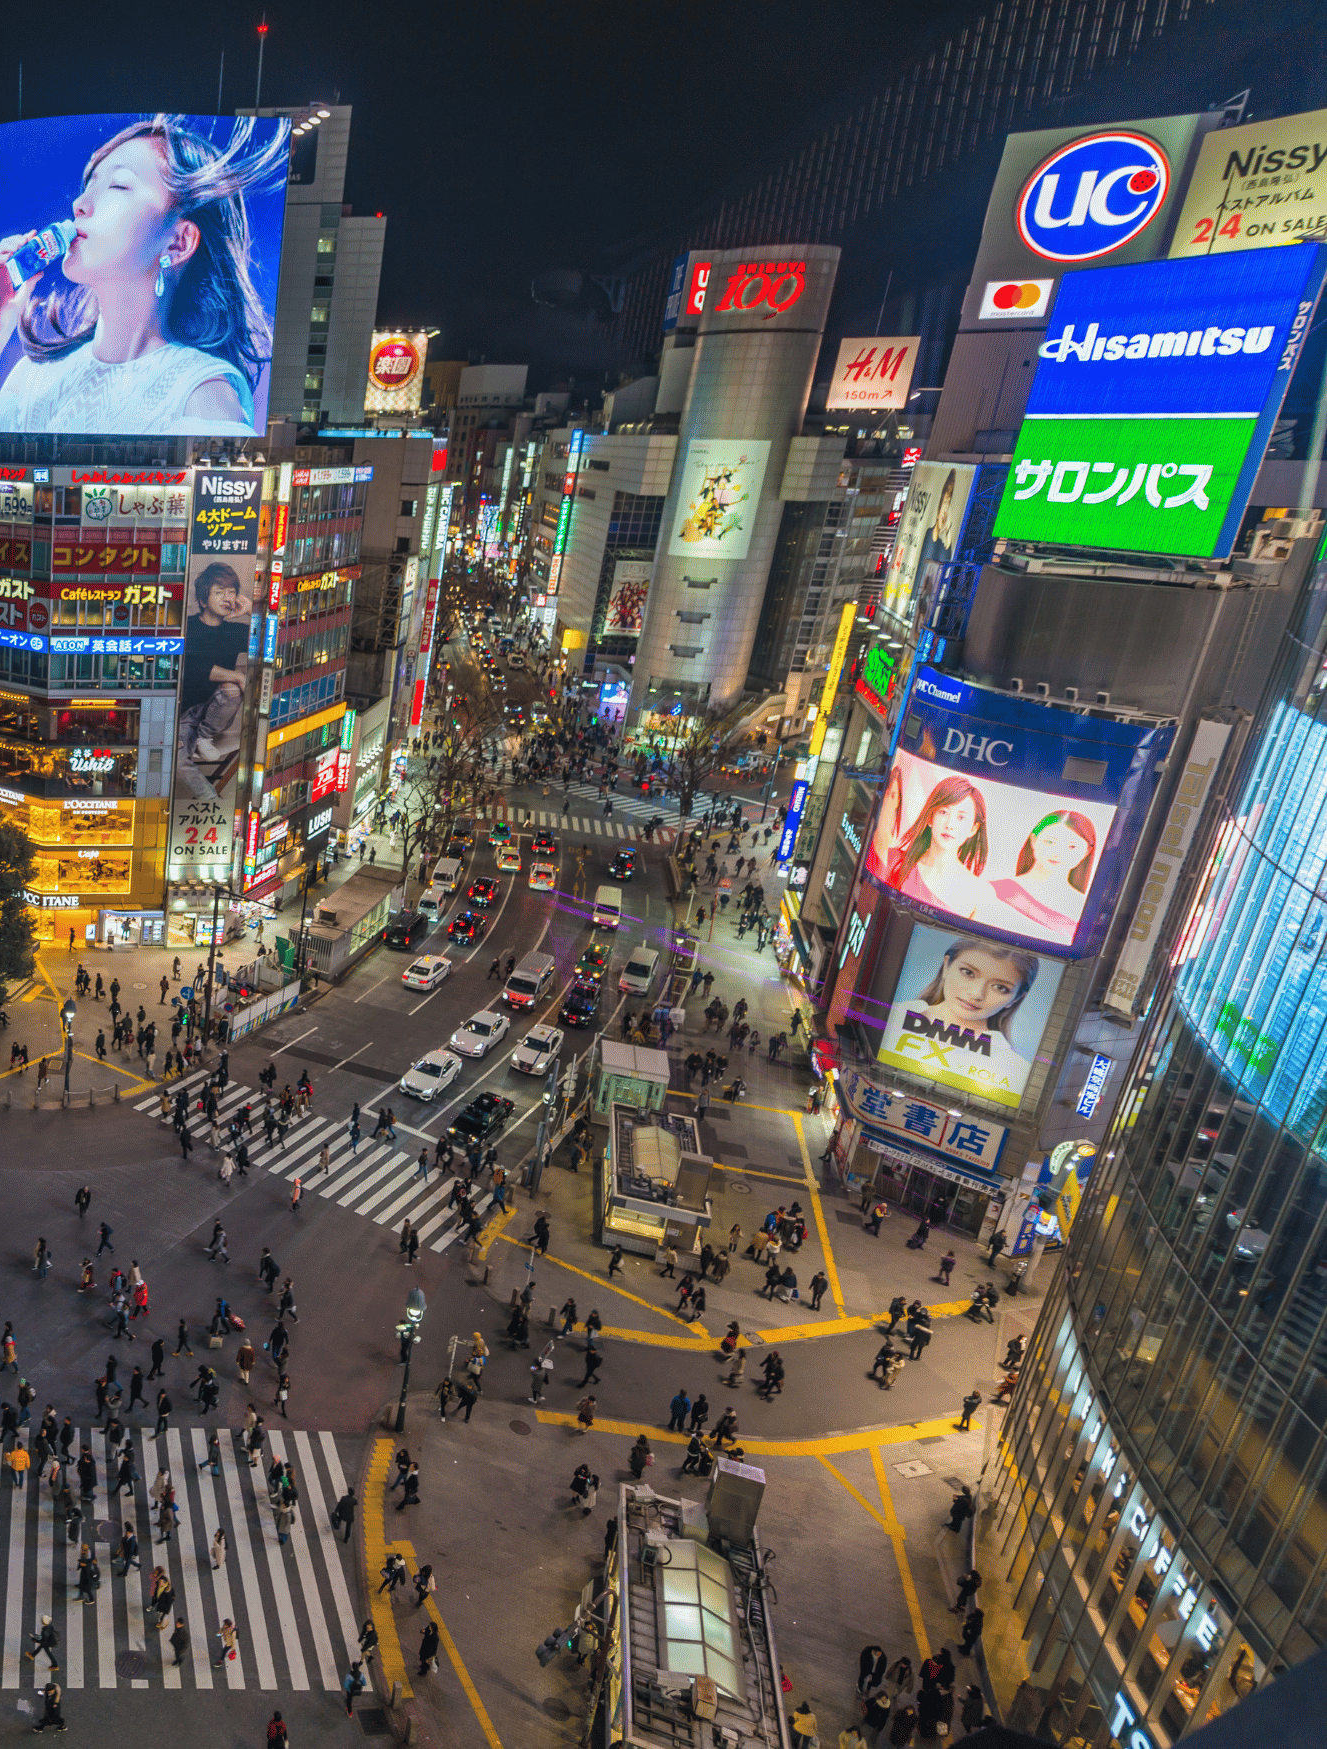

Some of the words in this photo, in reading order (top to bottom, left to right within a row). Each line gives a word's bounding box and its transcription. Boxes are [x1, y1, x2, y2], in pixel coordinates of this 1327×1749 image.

[1222, 142, 1327, 181] Nissy
[1217, 187, 1315, 212] ベストアルバム
[1245, 224, 1275, 238] ON
[1283, 215, 1327, 234] SALE
[737, 262, 806, 274] SHIBUYA
[715, 272, 805, 320] 109
[1038, 323, 1275, 362] Hisamitsu
[1277, 300, 1313, 371] サロンパス
[843, 347, 909, 382] H&M
[845, 390, 879, 400] 150m
[201, 476, 257, 499] Nissy
[1014, 459, 1214, 511] サロンパス
[118, 493, 186, 515] しゃぶ葉
[196, 506, 257, 524] 4大ドーム
[206, 523, 246, 537] ツアー
[202, 540, 248, 551] やります!!
[54, 547, 157, 567] コンタクト
[124, 585, 173, 604] ガスト
[55, 640, 85, 651] AEON
[92, 639, 181, 652] 英会話イーオン
[928, 683, 962, 703] Channel
[943, 728, 1013, 766] DHC
[63, 800, 117, 810] L'OCCITANE
[187, 802, 221, 813] ベスト
[179, 814, 226, 826] アルバム
[308, 807, 333, 835] LUSH
[185, 827, 218, 845] 2.4
[174, 846, 198, 856] ON
[202, 846, 228, 856] SALE
[902, 1010, 992, 1057] DMM
[895, 1033, 954, 1068] FX
